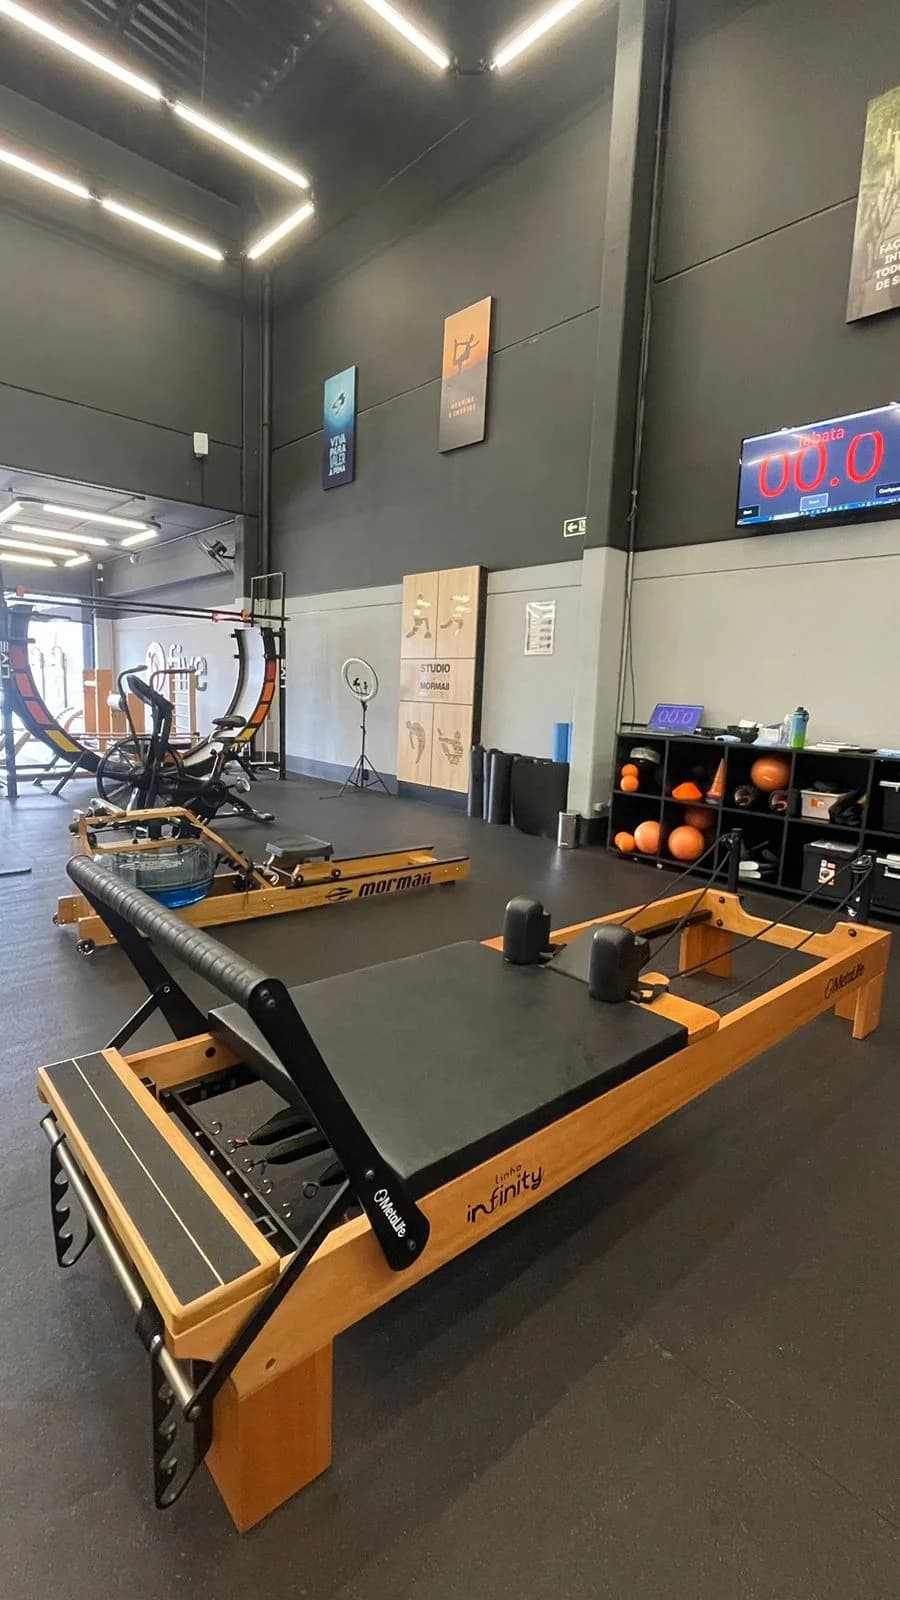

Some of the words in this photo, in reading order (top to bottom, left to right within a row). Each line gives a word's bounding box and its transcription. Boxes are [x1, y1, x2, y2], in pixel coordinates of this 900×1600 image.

[876, 279, 890, 291] DE
[892, 275, 900, 285] S
[758, 430, 884, 498] 00.0
[420, 663, 451, 673] STUDIO
[358, 872, 432, 897] mormaii
[467, 1166, 542, 1223] infinity
[379, 1196, 406, 1238] MetaLife
